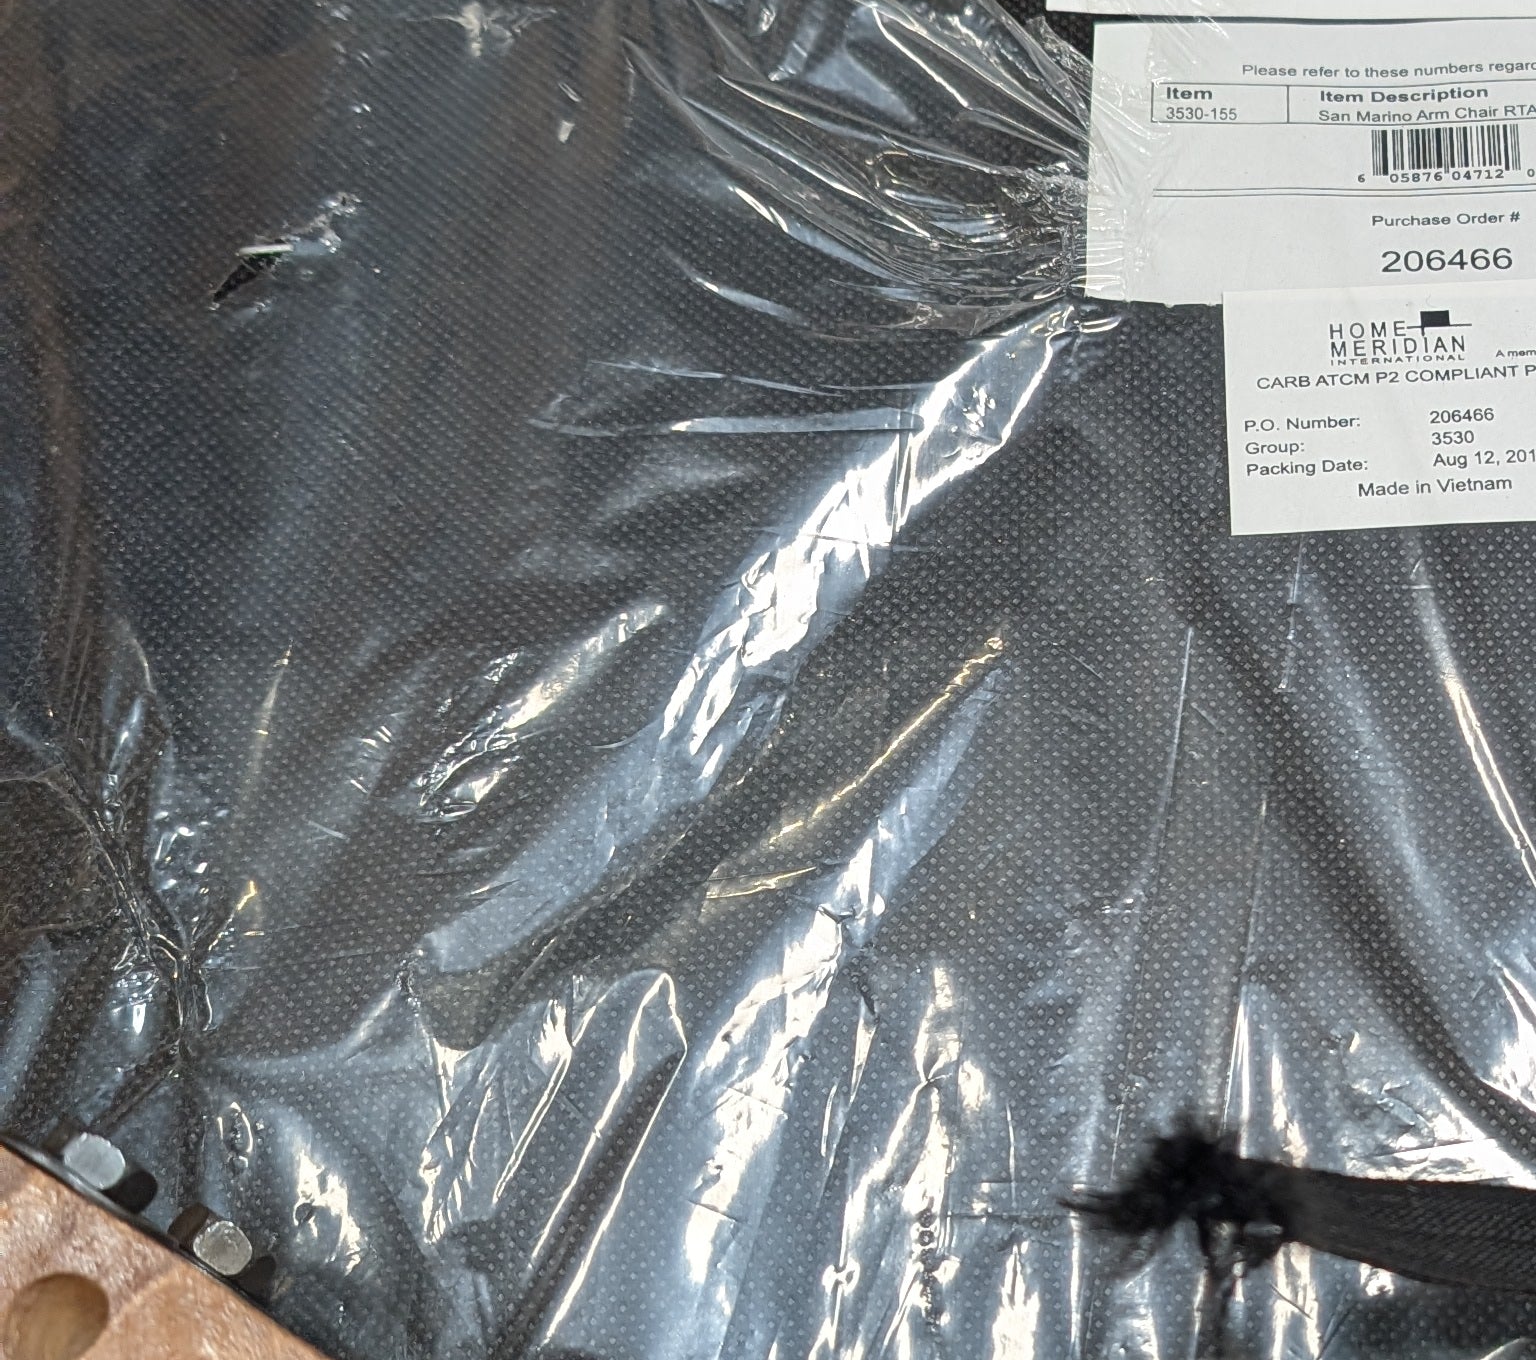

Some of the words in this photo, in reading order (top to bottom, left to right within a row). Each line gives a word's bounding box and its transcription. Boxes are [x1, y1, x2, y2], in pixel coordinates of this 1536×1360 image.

[1243, 65, 1297, 76] Please
[1303, 67, 1340, 77] refer
[1345, 68, 1360, 78] to
[1365, 67, 1408, 78] these
[1414, 63, 1483, 76] numbers
[1167, 87, 1212, 99] Item
[1321, 91, 1363, 102] Item
[1371, 87, 1488, 102] Description
[1166, 107, 1237, 120] 3530-155
[1319, 110, 1350, 121] San
[1357, 111, 1412, 122] Marino
[1416, 110, 1449, 121] Arm
[1455, 106, 1498, 119] Chair
[1358, 174, 1365, 183] 6
[1390, 171, 1442, 183] 05876
[1452, 169, 1504, 180] 04712
[1527, 169, 1535, 177] 0
[1372, 216, 1451, 226] Purchase
[1457, 213, 1505, 224] Order
[1510, 211, 1520, 222] #
[1382, 248, 1512, 272] 206466
[1330, 321, 1406, 339] HOME
[1331, 332, 1464, 357] MERIDIAN
[1331, 350, 1464, 366] INTERNATIONAL
[1257, 376, 1310, 389] CARB
[1316, 373, 1369, 386] ATCM
[1376, 372, 1399, 383] P2
[1405, 365, 1518, 382] COMPLIANT
[1245, 419, 1279, 432] P.O.
[1287, 416, 1360, 430] Number:
[1430, 408, 1494, 424] 206466
[1245, 442, 1304, 455] Group:
[1432, 430, 1474, 445] 3530
[1247, 461, 1315, 476] Packing
[1322, 460, 1367, 472] Date:
[1433, 453, 1467, 469] Aug
[1475, 451, 1500, 466] 12,
[1358, 482, 1409, 497] Made
[1416, 480, 1431, 494] in
[1437, 478, 1512, 492] Vietnam
